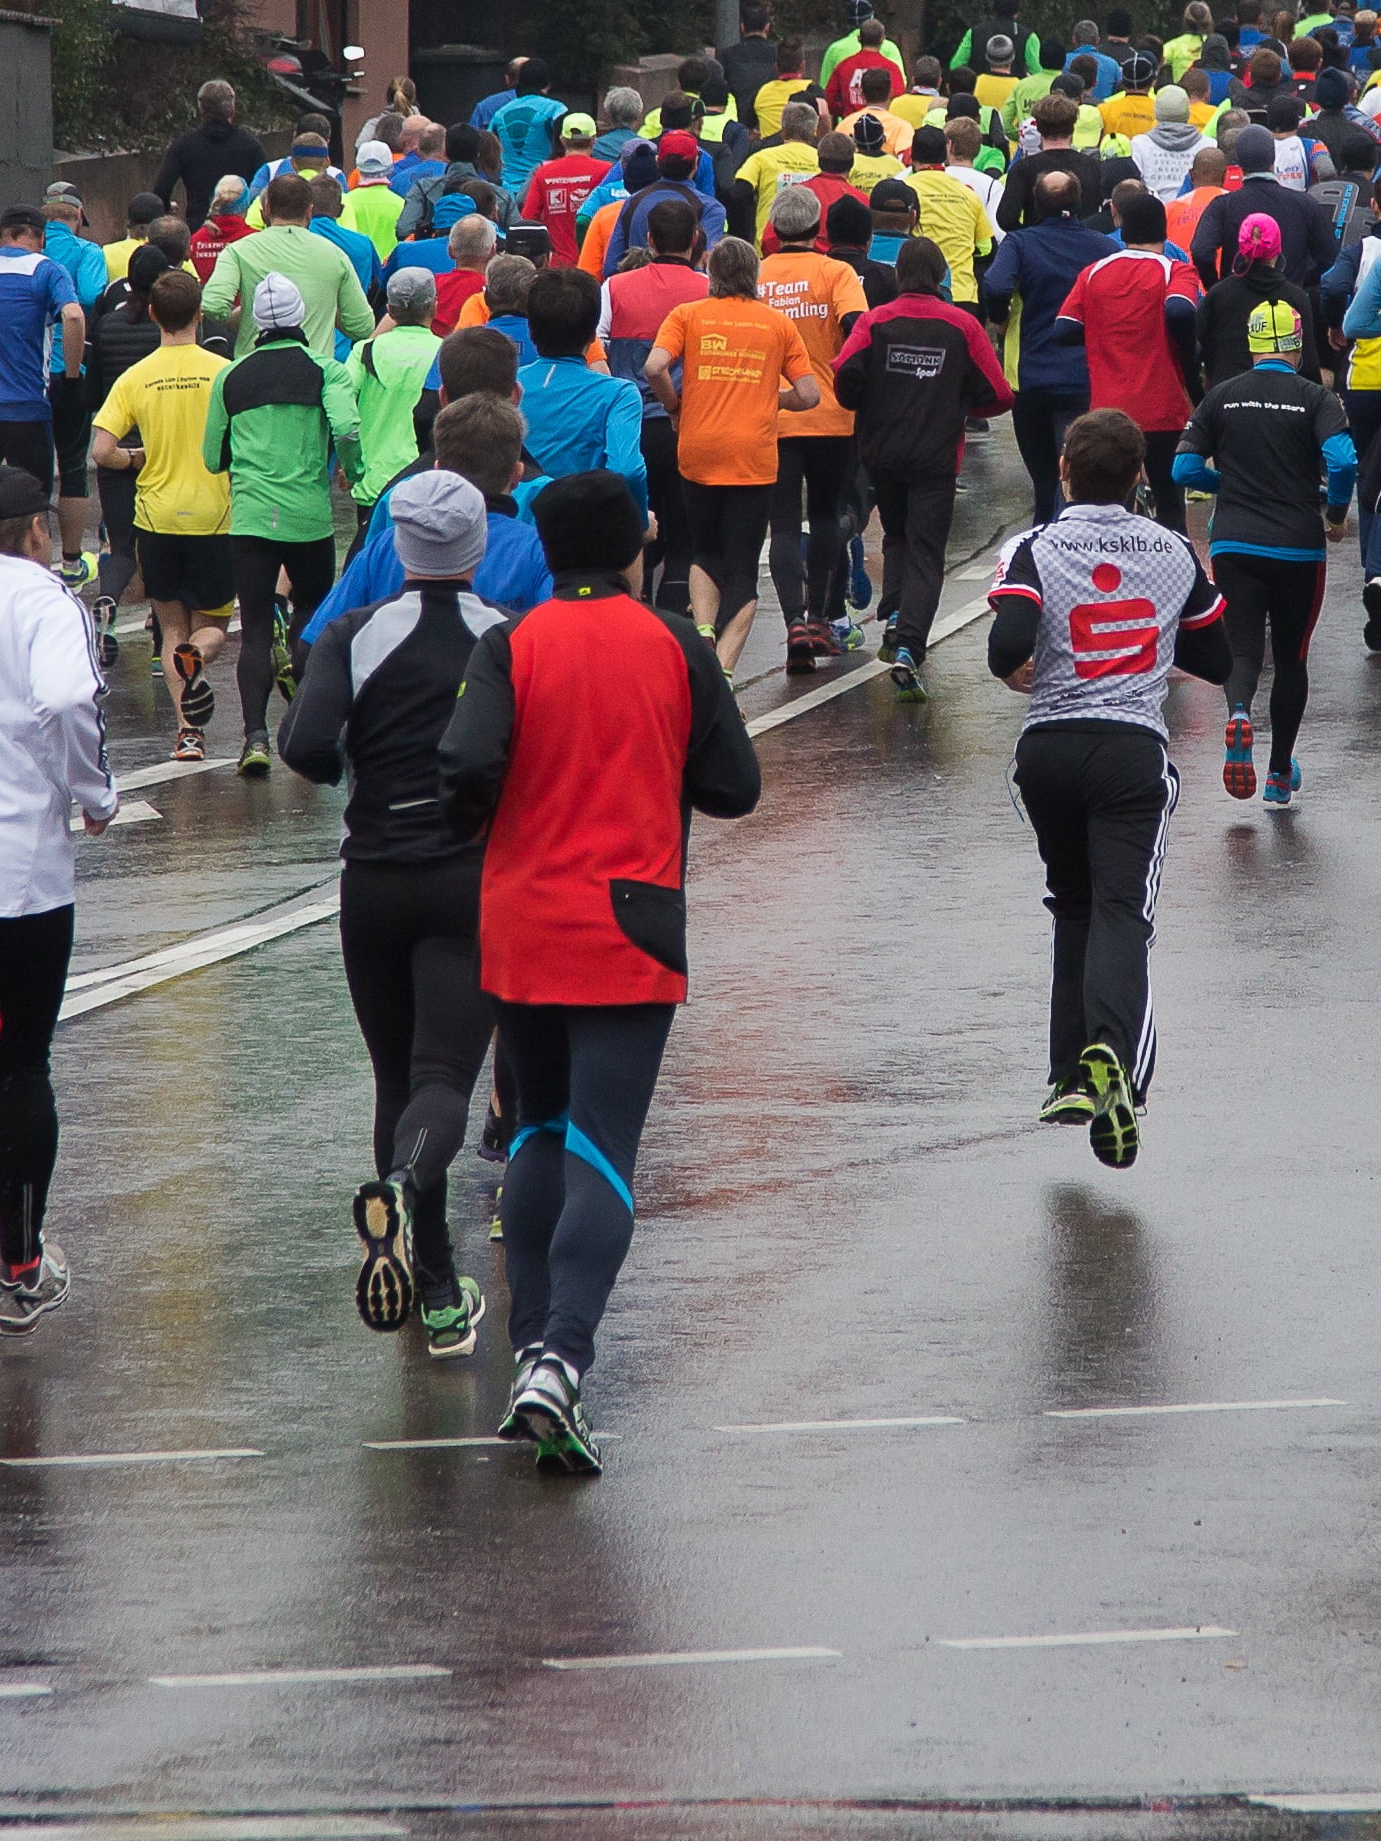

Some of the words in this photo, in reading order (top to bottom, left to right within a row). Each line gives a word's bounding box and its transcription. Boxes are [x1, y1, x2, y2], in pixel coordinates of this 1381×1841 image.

[1241, 401, 1262, 409] with
[1264, 402, 1279, 410] the
[1051, 535, 1172, 554] www.ksklb.de
